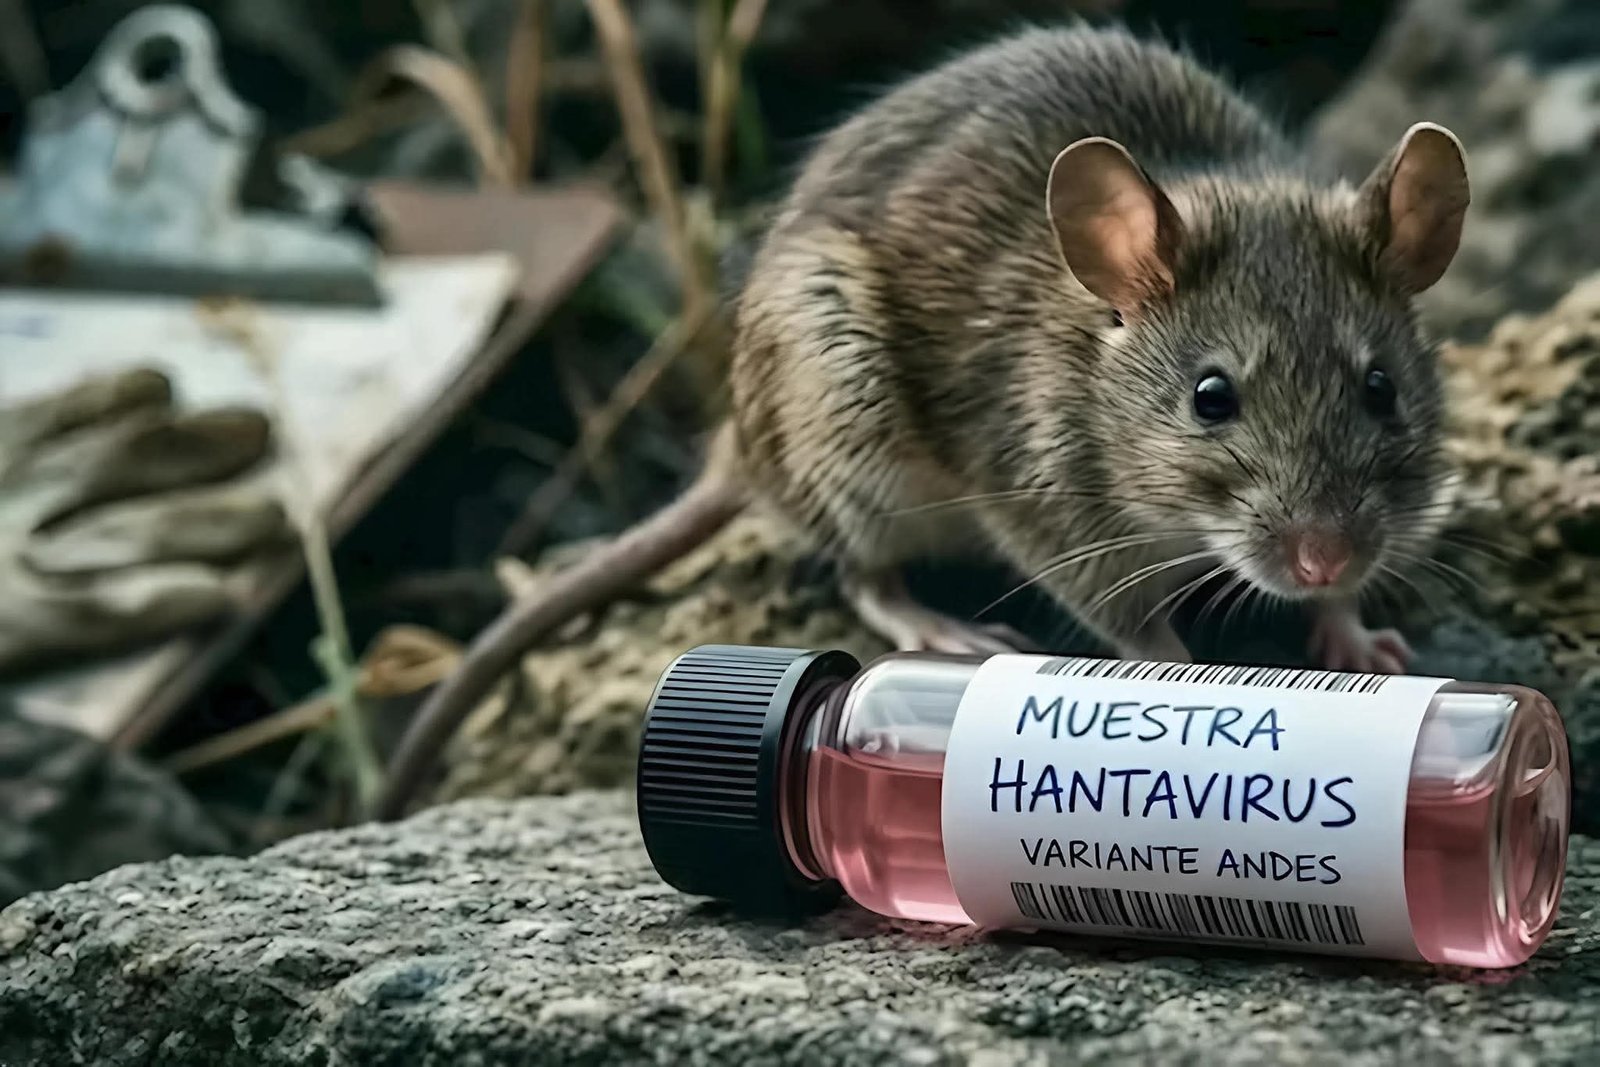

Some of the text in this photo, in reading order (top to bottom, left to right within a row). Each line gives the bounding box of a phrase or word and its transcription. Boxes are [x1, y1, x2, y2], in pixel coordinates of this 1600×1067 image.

[1016, 696, 1286, 751] MUESTRA
[988, 757, 1357, 828] HANTAVIRUS
[1020, 838, 1343, 885] VARIANTE ANDES
